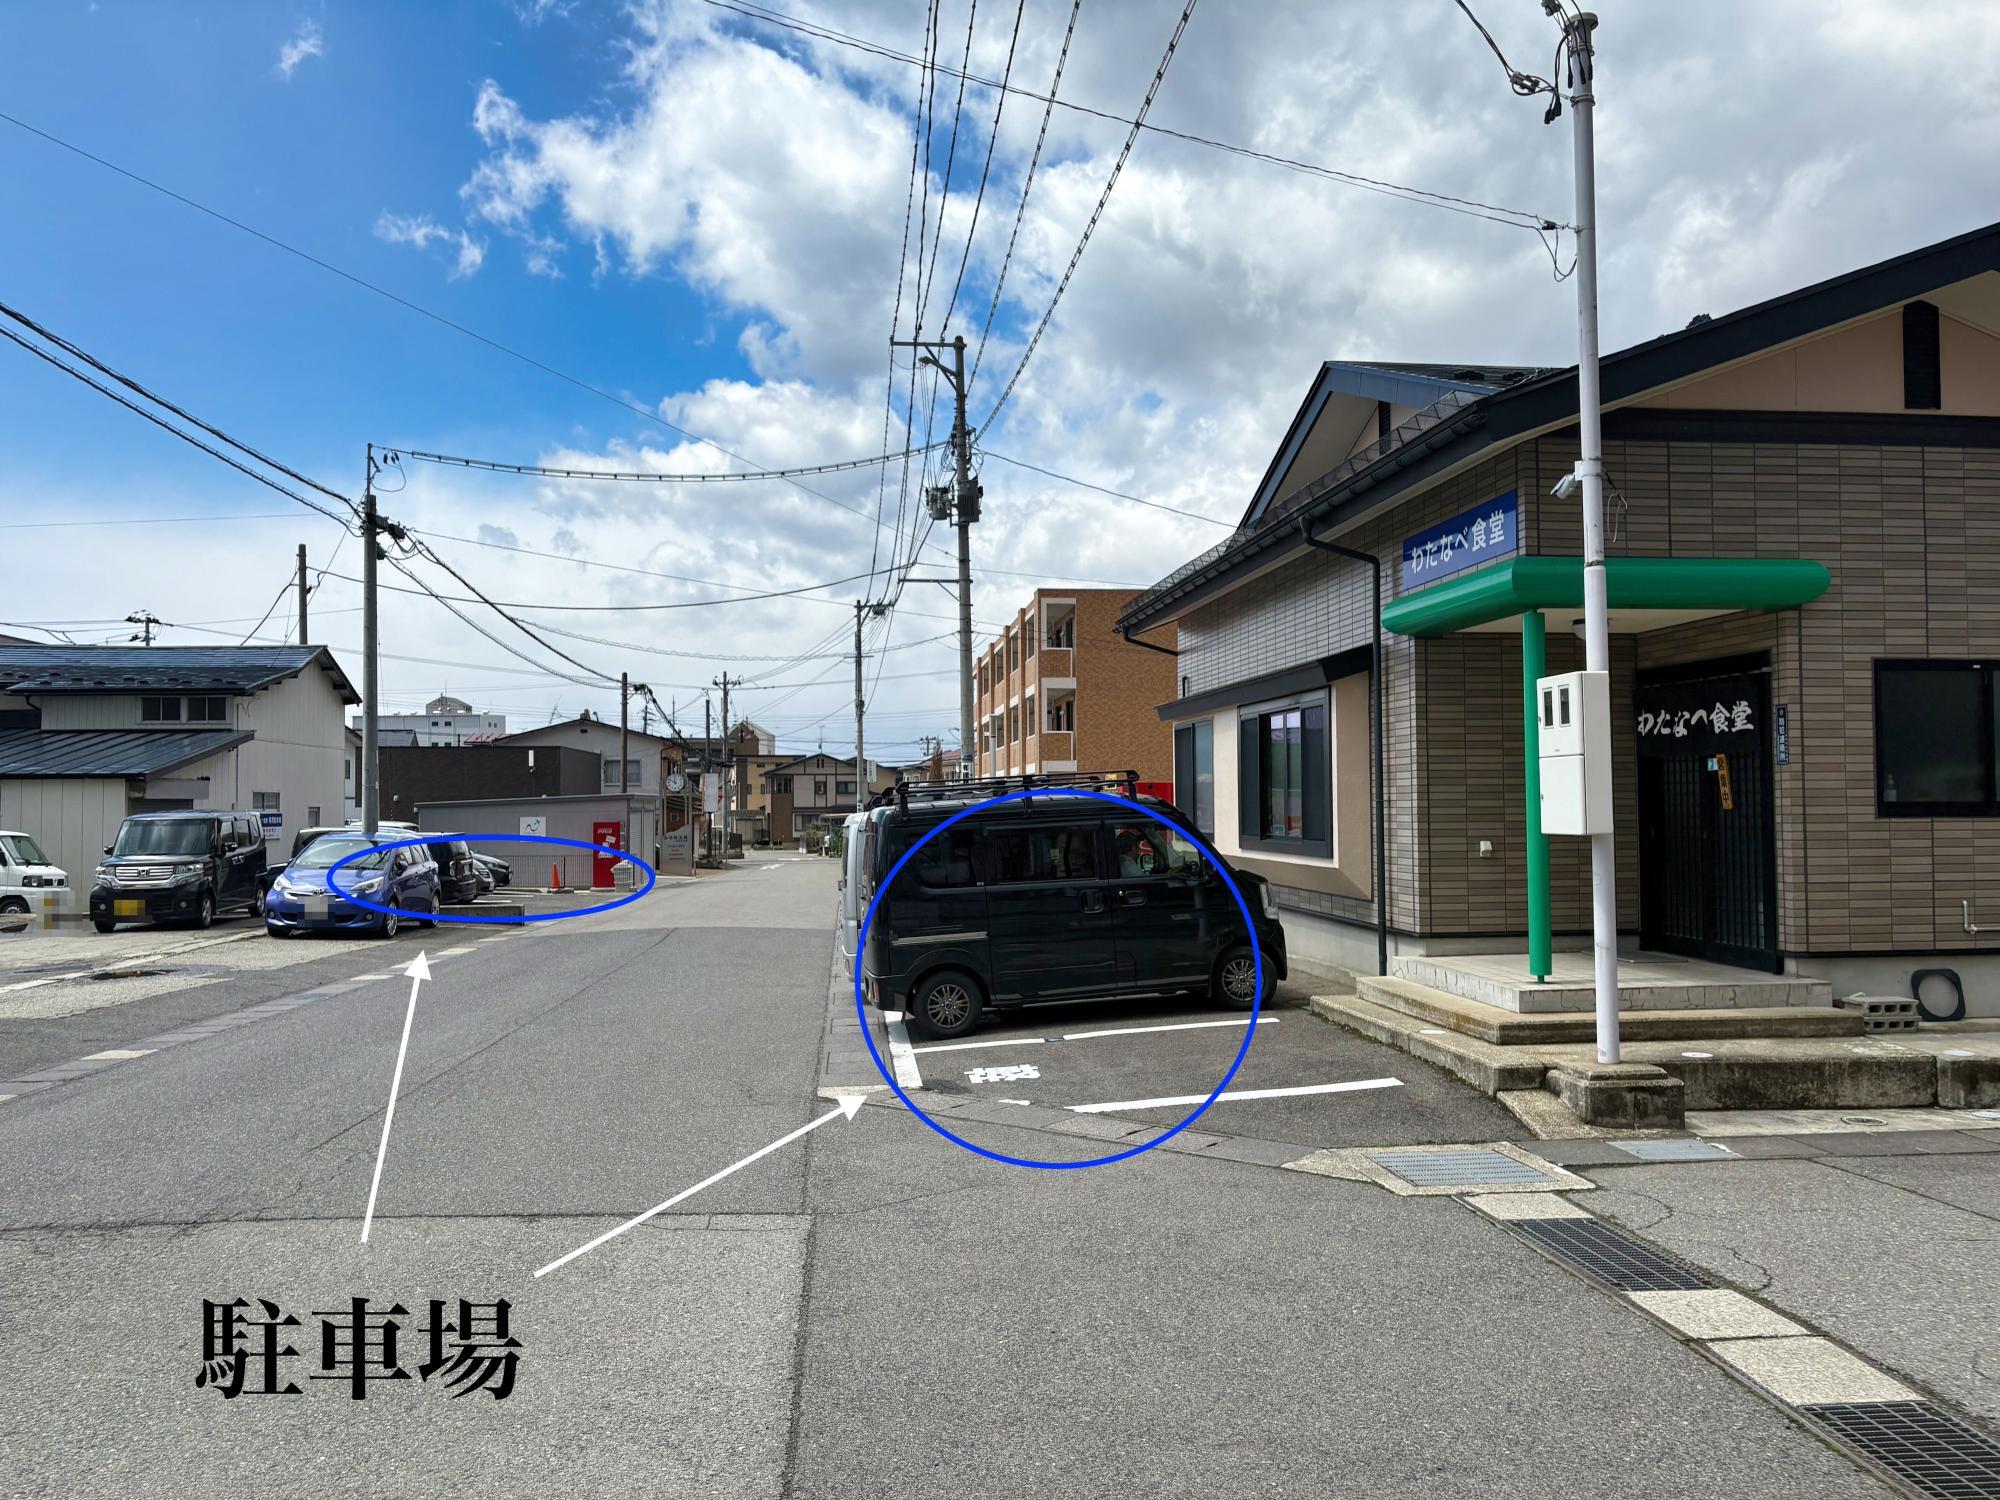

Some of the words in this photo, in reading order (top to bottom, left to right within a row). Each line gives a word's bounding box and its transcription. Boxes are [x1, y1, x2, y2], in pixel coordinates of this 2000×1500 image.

[1411, 509, 1505, 574] わたなべ食堂
